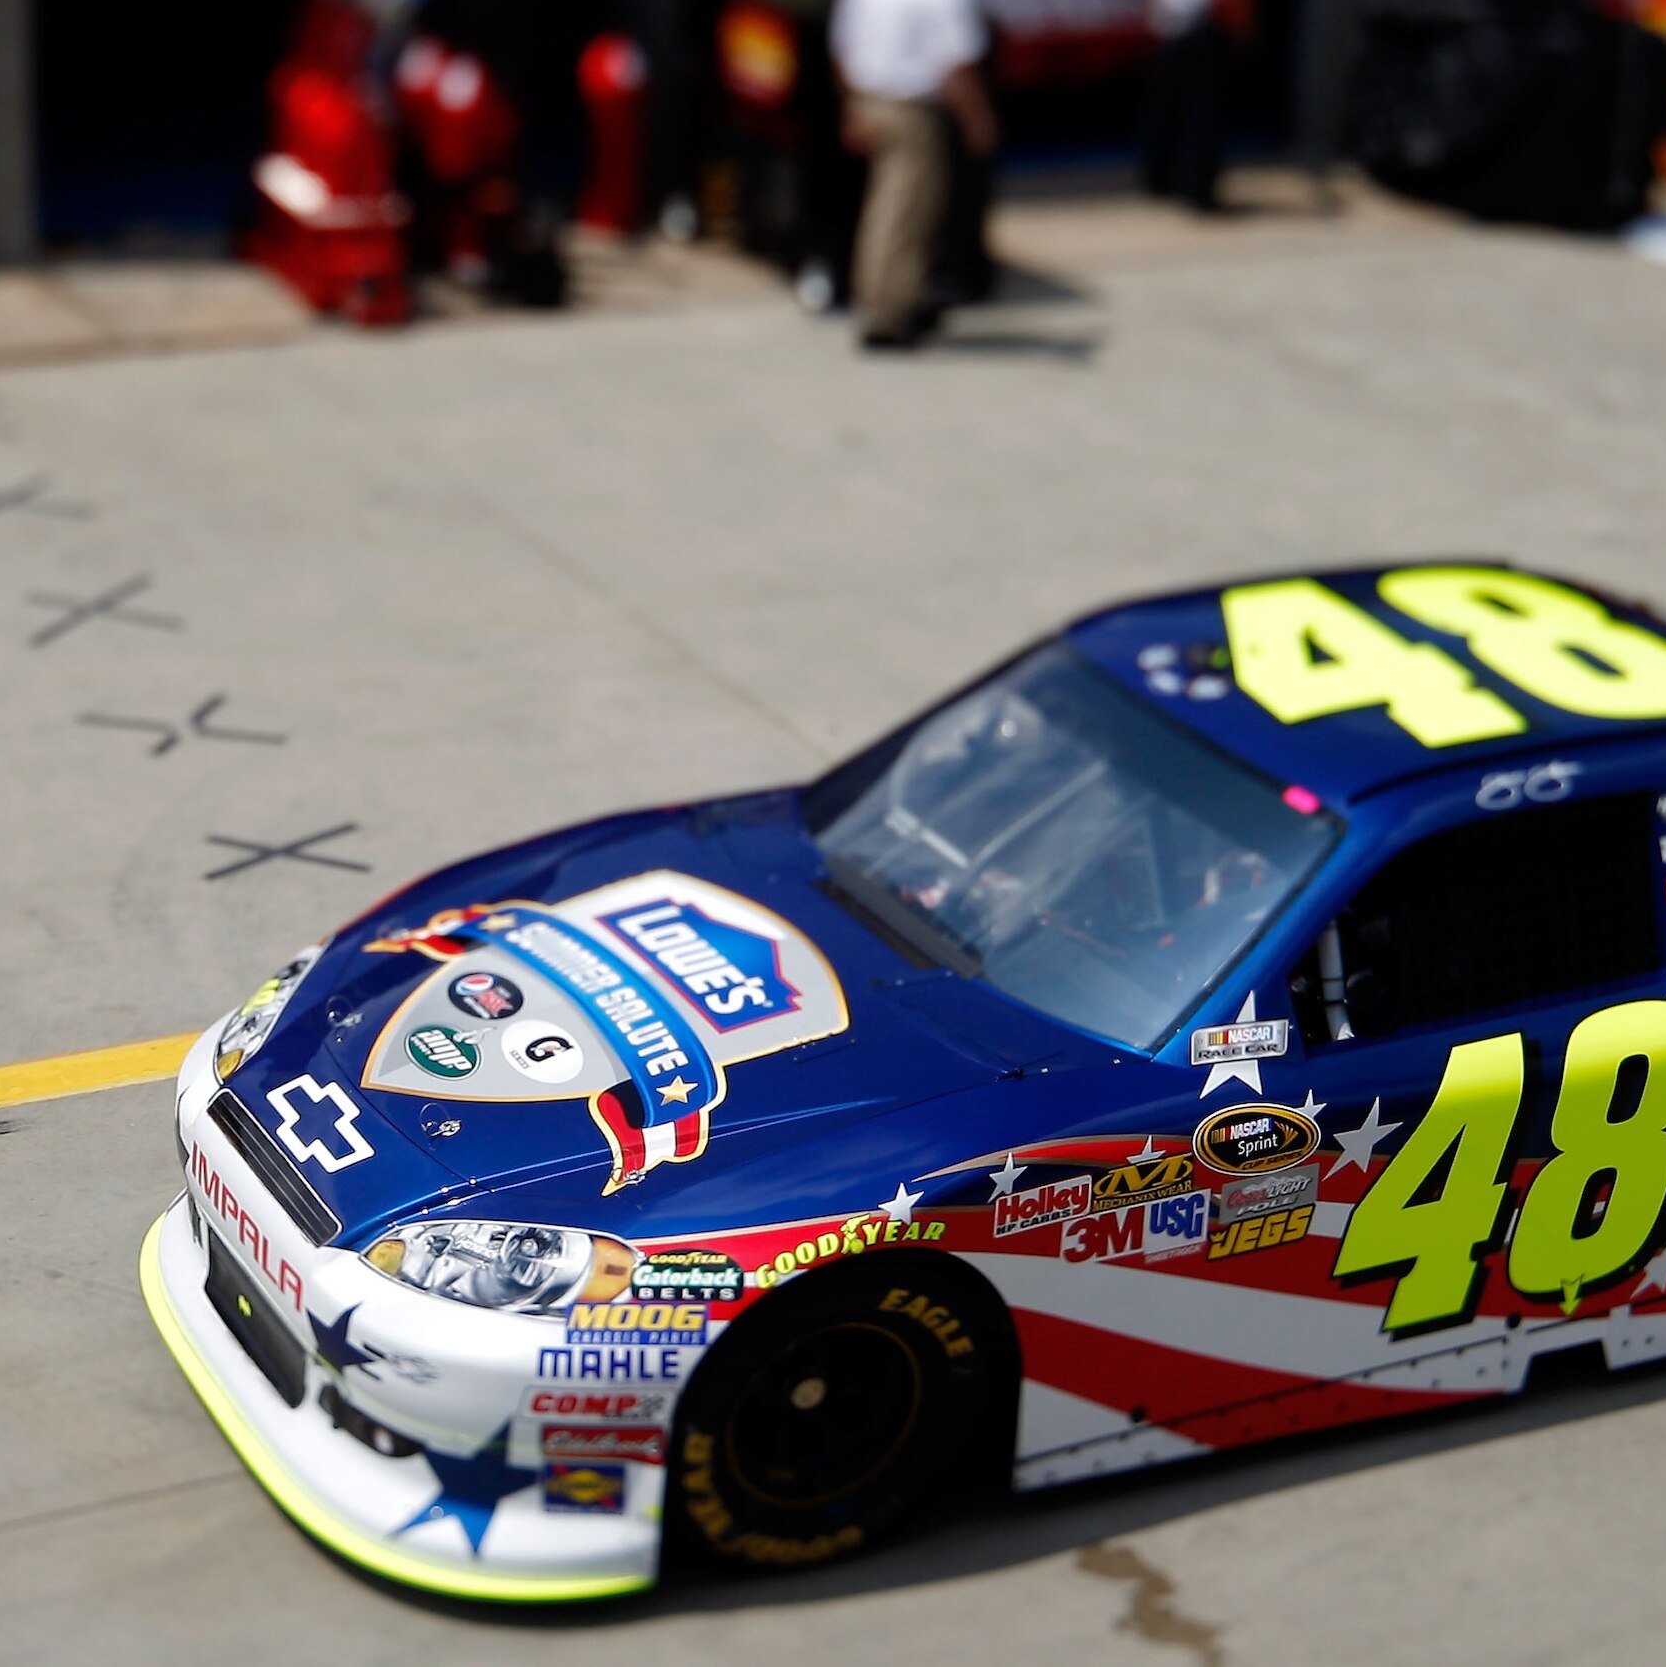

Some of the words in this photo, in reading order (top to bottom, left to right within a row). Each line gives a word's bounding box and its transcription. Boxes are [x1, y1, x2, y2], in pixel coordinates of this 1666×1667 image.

[617, 905, 767, 1015] LOWE'S
[596, 987, 689, 1077] SALUTE
[1228, 1026, 1271, 1044] NASCAR
[1198, 1046, 1242, 1059] RACE
[1244, 1043, 1278, 1053] CAR
[1230, 1118, 1270, 1140] NASCAR
[1238, 1134, 1278, 1157] Sprint
[1157, 1179, 1193, 1198] WEAR
[1268, 1176, 1312, 1199] LIGHT
[997, 1183, 1090, 1226] Holley
[1149, 1193, 1205, 1239] USG
[191, 1140, 304, 1312] IMPALA
[1063, 1205, 1145, 1263] 3M
[1208, 1206, 1313, 1259] JEGS
[648, 1252, 728, 1265] GOODYEAR
[755, 1217, 946, 1289] GOODYEAR
[633, 1265, 741, 1286] Gatorback
[638, 1287, 735, 1300] BELTS
[568, 1304, 707, 1331] MOOG
[877, 1288, 975, 1358] EAGLE
[538, 1347, 680, 1379] MAHLE
[532, 1393, 638, 1415] COMP
